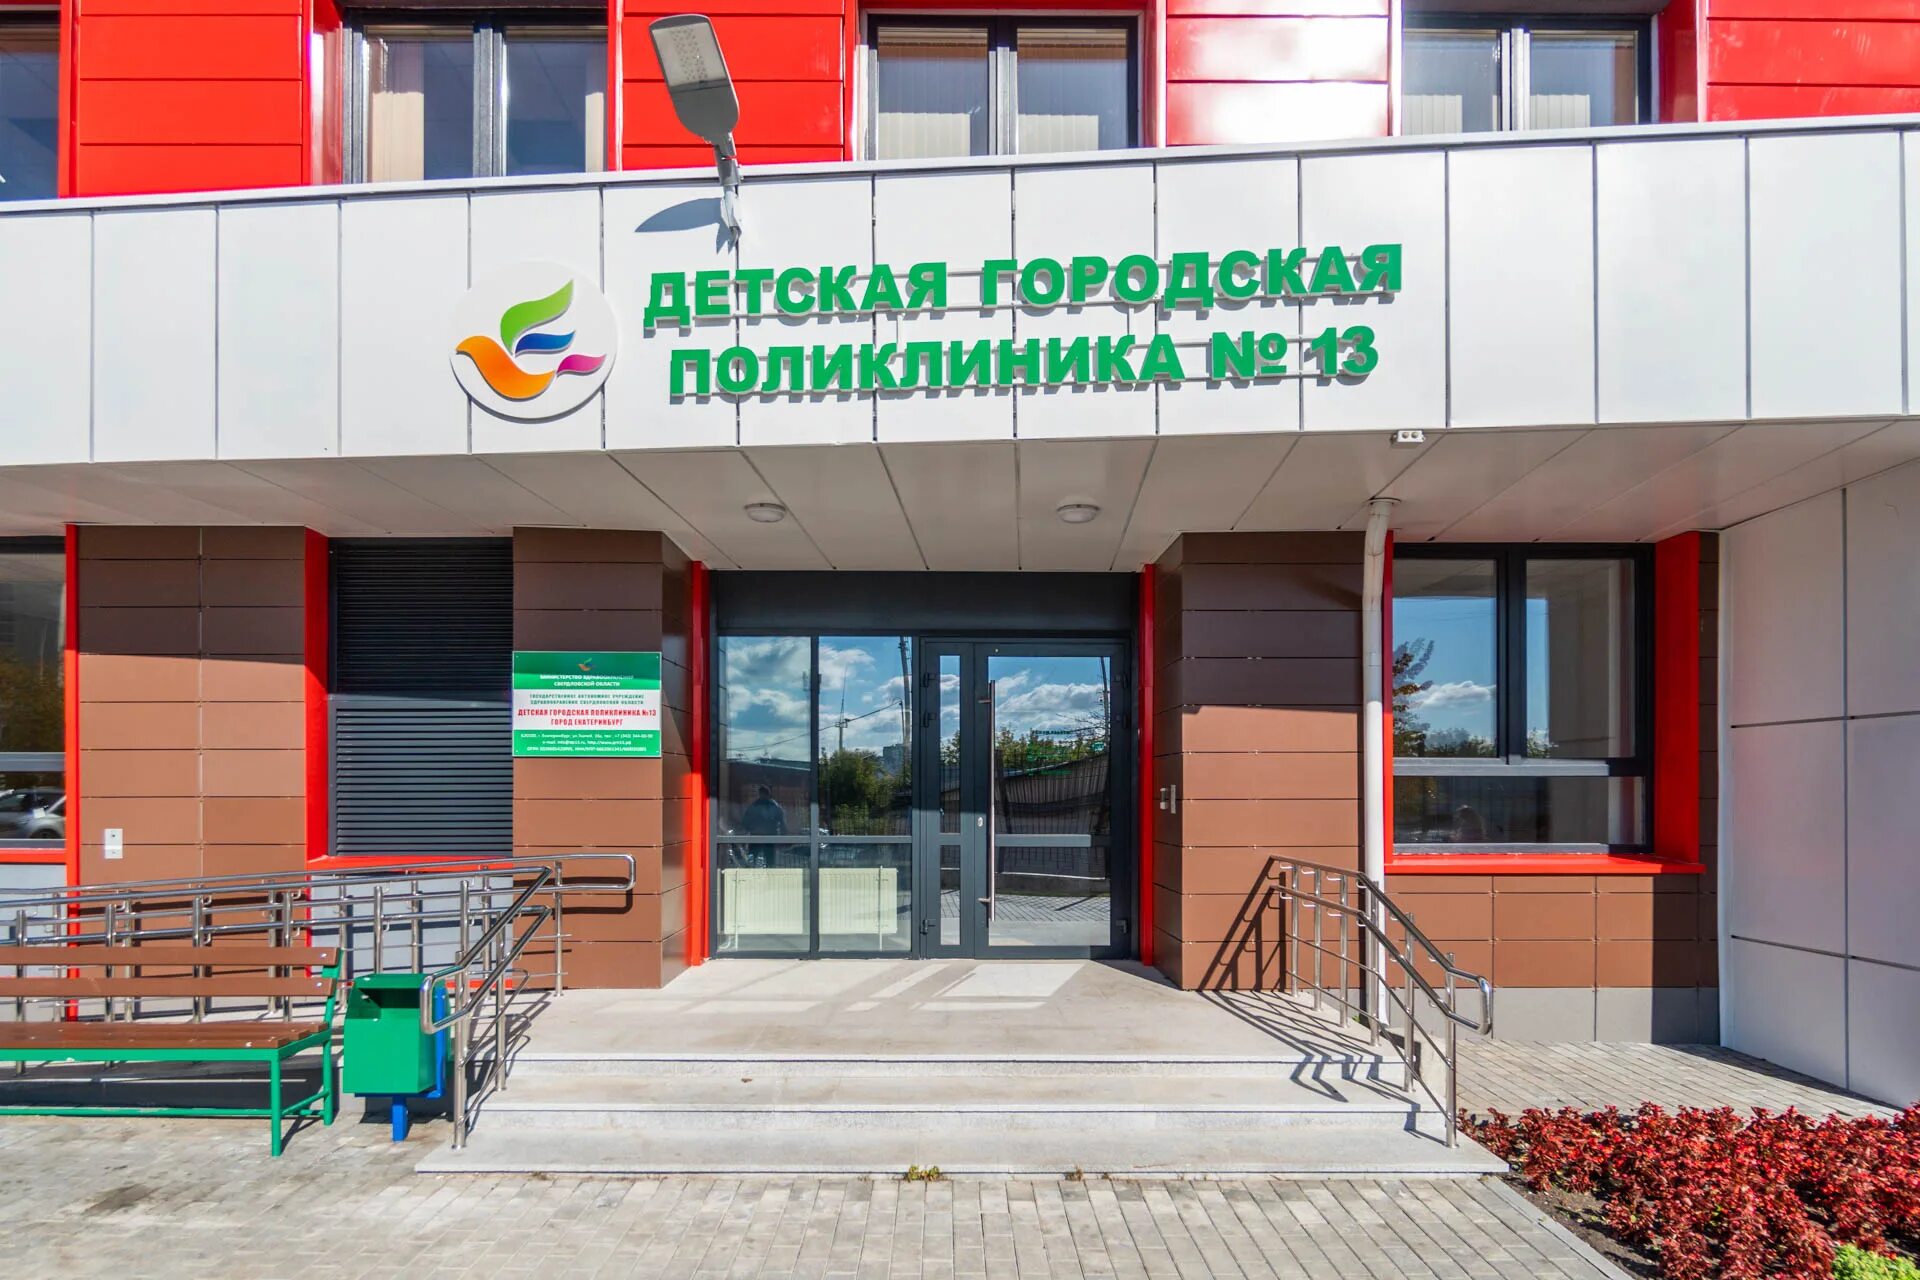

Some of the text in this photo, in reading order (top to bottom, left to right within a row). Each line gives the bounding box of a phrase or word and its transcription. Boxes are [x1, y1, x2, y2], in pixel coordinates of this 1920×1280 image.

[643, 243, 1403, 329] ДЕТСКАЯ ГОРОДСКАЯ
[669, 325, 1379, 395] ПОЛИКЛИНИКА № 13
[517, 709, 548, 717] ДЕТСКАЯ
[551, 718, 624, 727] ГОРОД ЕКАТЕРИНБУРГ
